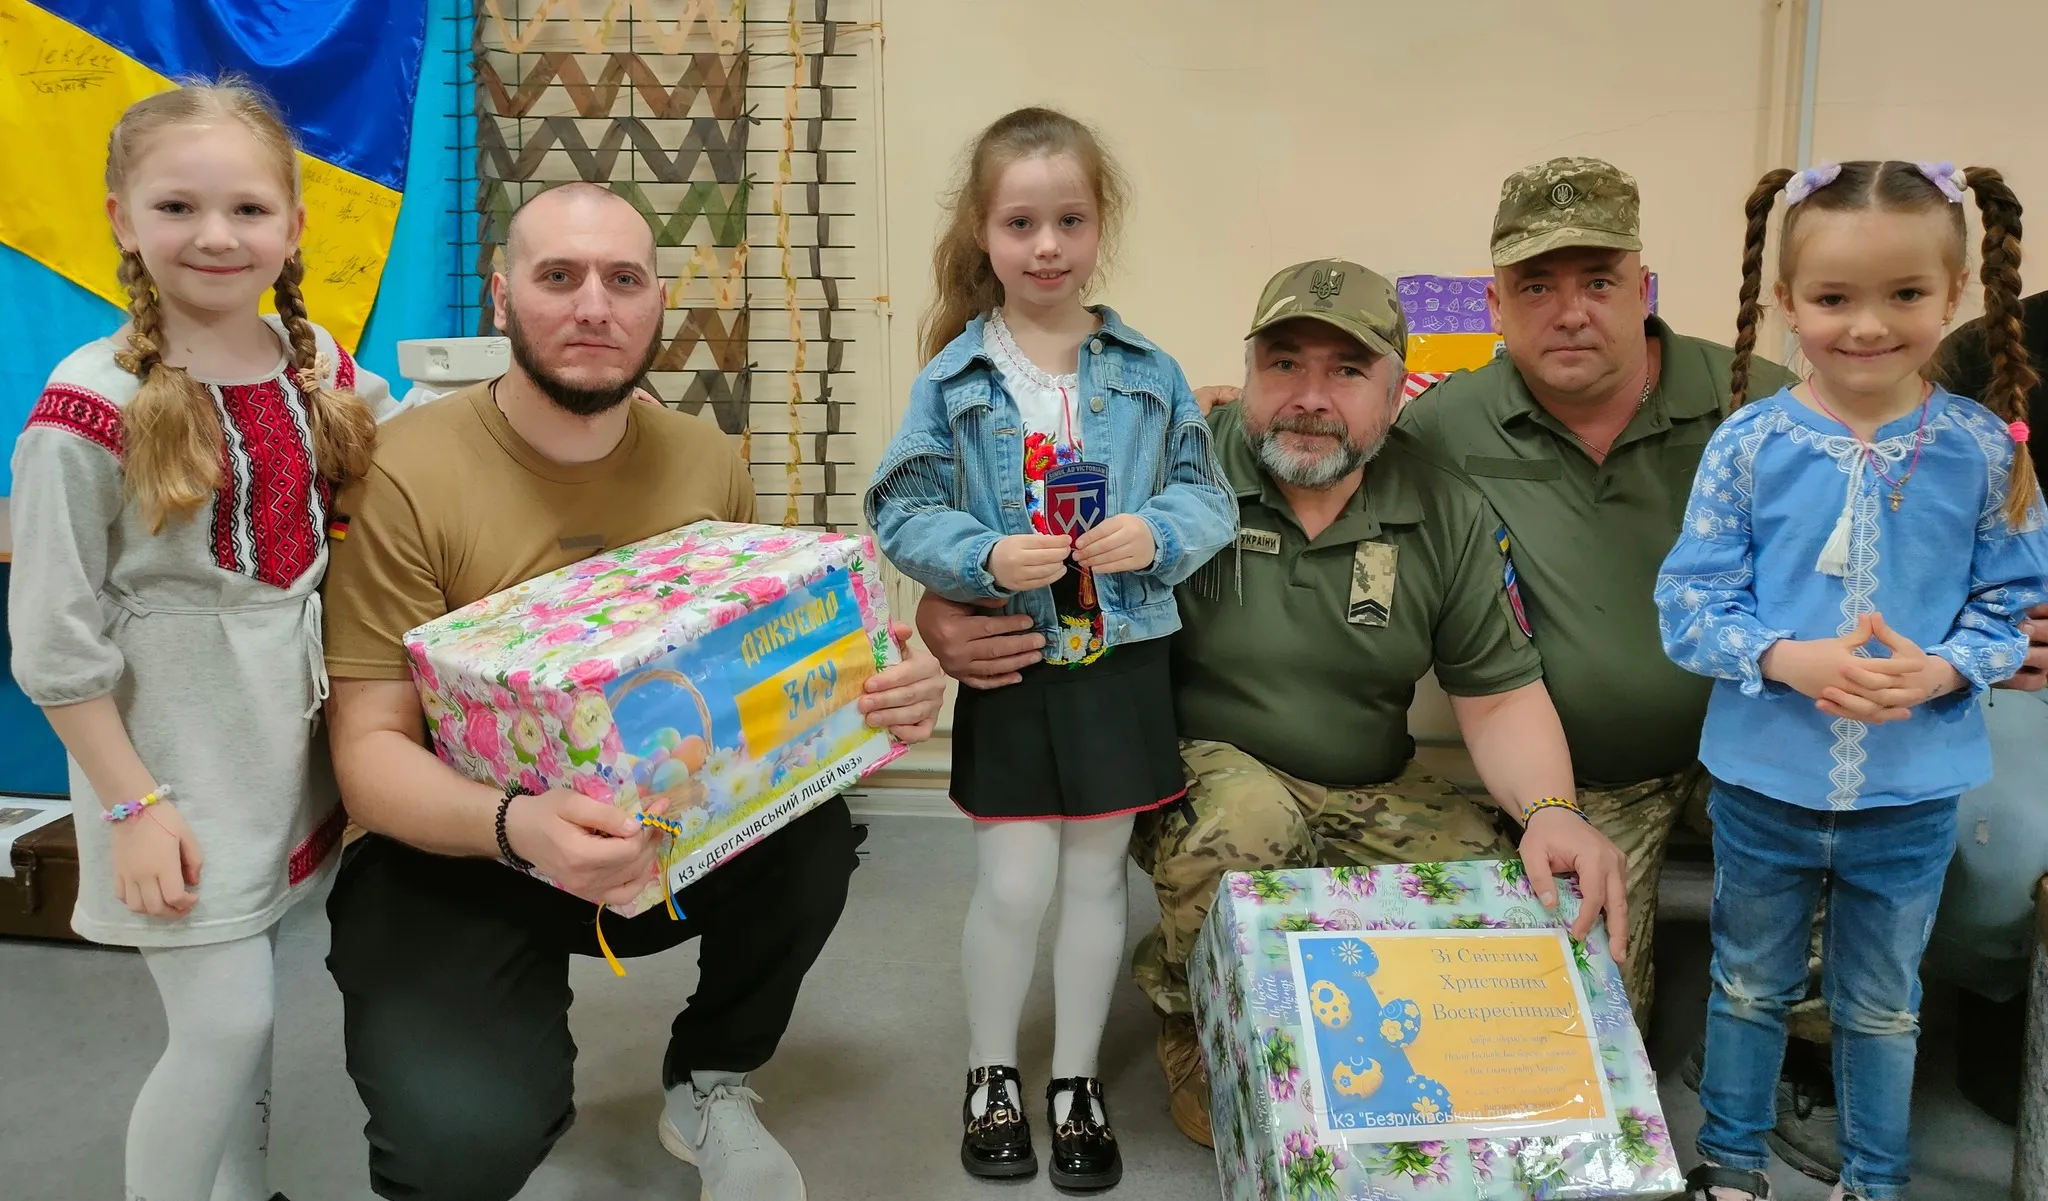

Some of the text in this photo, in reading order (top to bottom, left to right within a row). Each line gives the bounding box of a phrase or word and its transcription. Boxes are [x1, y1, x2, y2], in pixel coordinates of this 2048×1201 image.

[1066, 466, 1076, 474] AD
[1240, 534, 1277, 549] УКРАЇНИ
[783, 659, 838, 720] ЗСУ
[678, 756, 863, 883] КЗ «ДЕРГАЧІВСЬКИЙ ЛІЦЕЙ №3»
[1431, 948, 1539, 963] Зі Світлим
[1439, 974, 1548, 993] Христовим
[1432, 1001, 1575, 1022] Воскресінням!
[1334, 1113, 1355, 1128] КЗ
